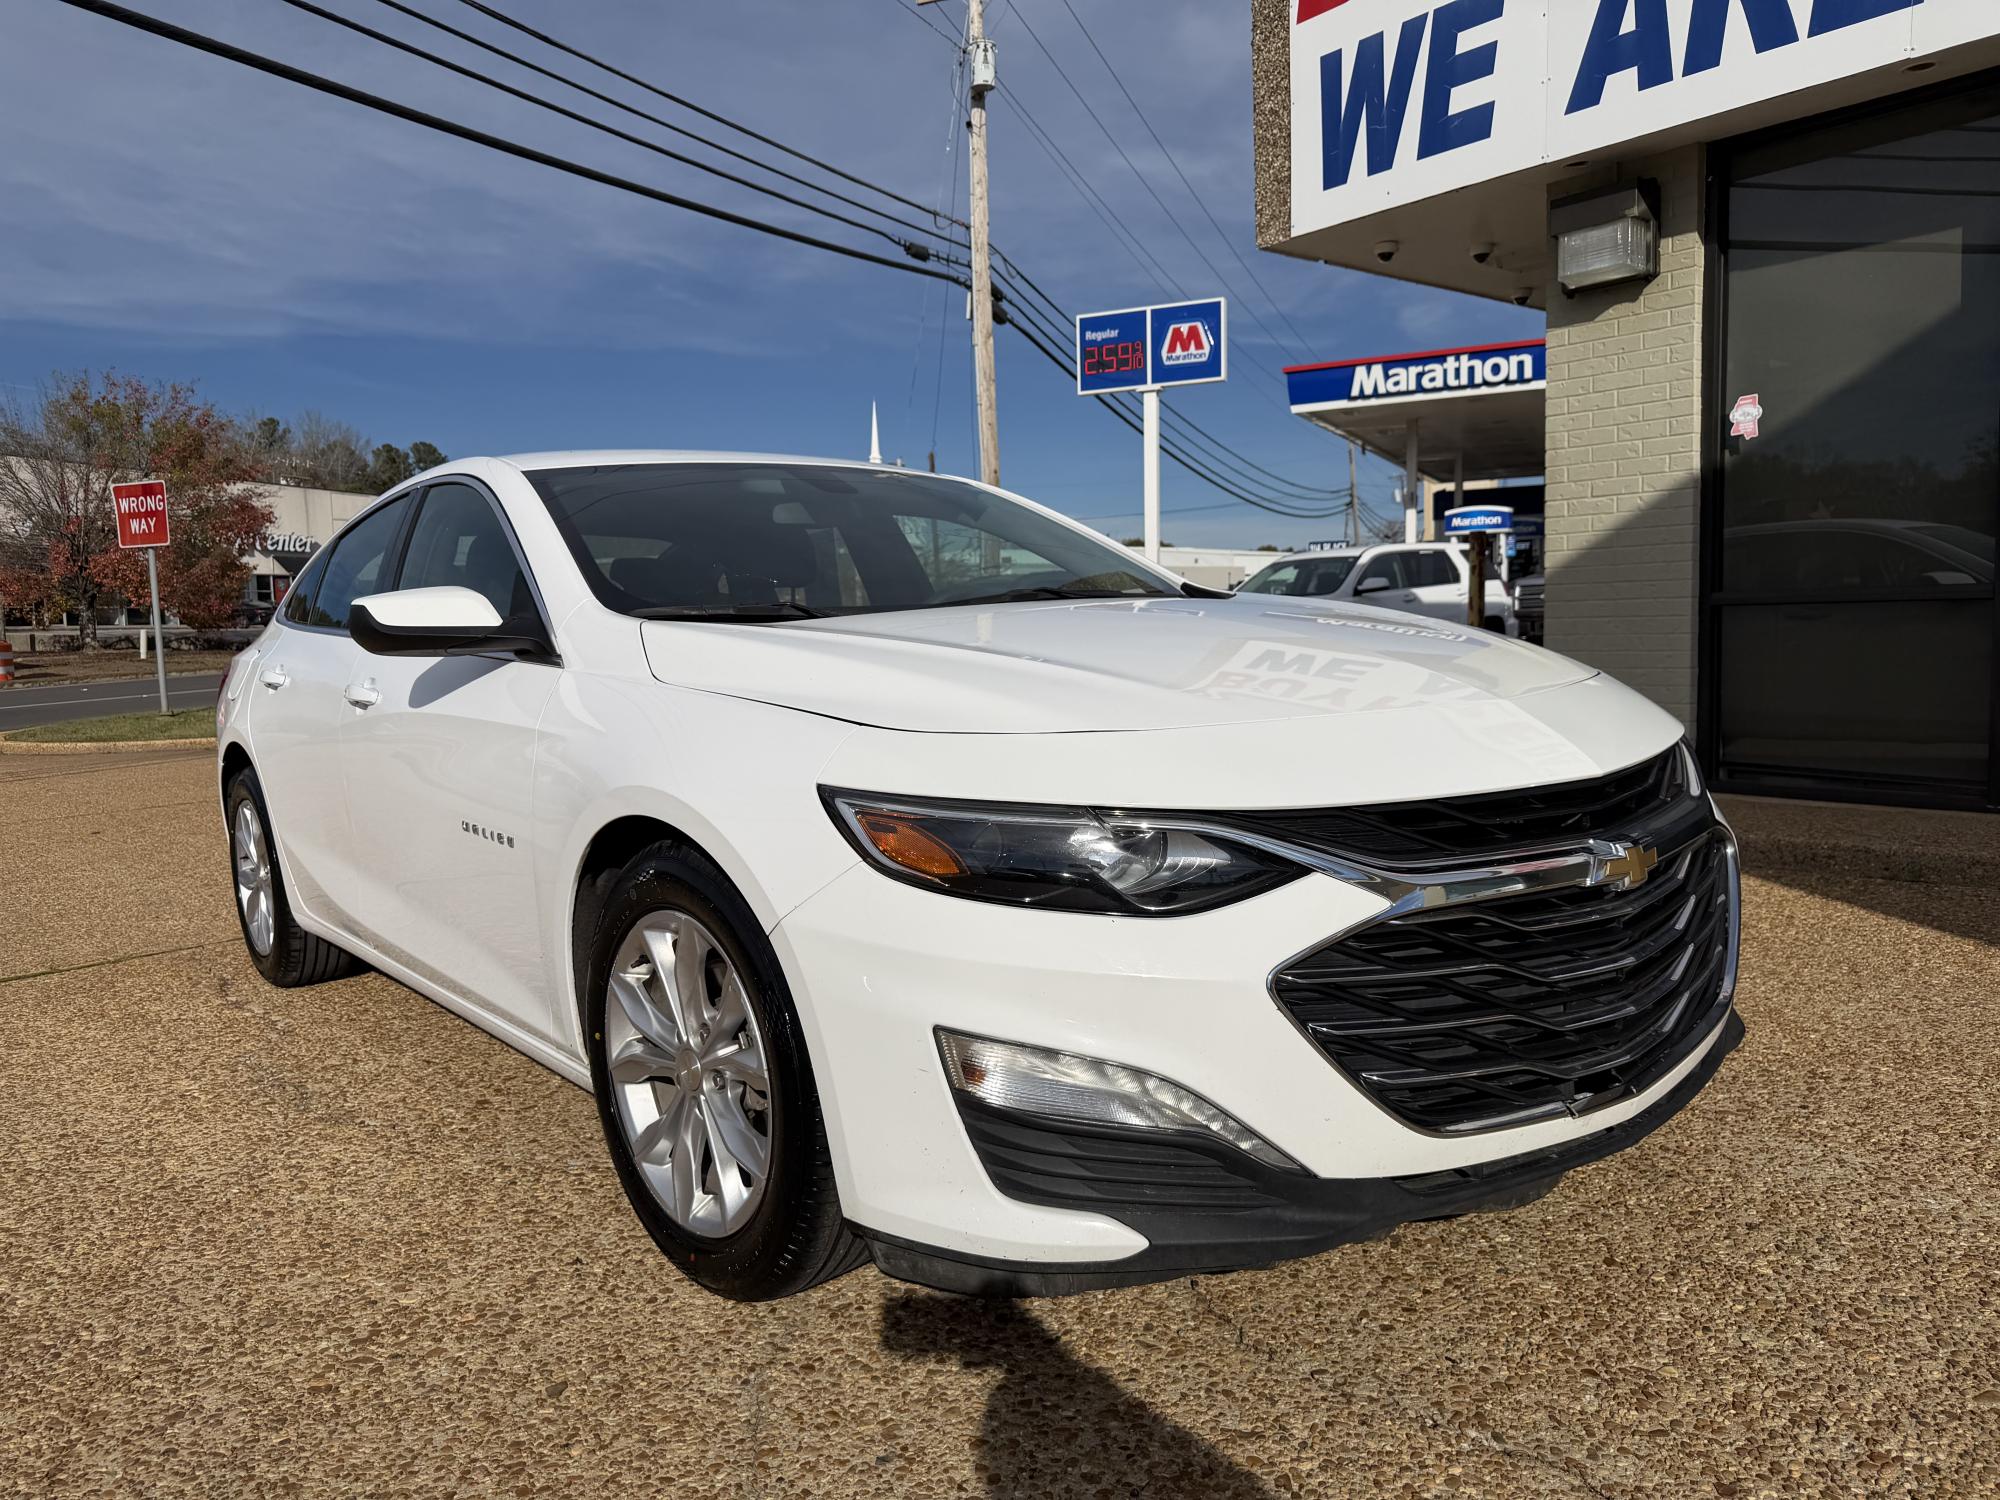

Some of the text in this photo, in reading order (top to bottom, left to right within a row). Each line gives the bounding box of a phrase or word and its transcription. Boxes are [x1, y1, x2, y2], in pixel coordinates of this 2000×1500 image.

[1320, 0, 1505, 191] WE
[1085, 328, 1119, 341] Regular
[1165, 351, 1207, 362] Marathon
[1350, 353, 1533, 397] Marathon
[118, 494, 164, 514] WRONG
[129, 516, 156, 534] WAY
[1451, 515, 1502, 527] Marathon
[461, 820, 515, 849] MALIBU
